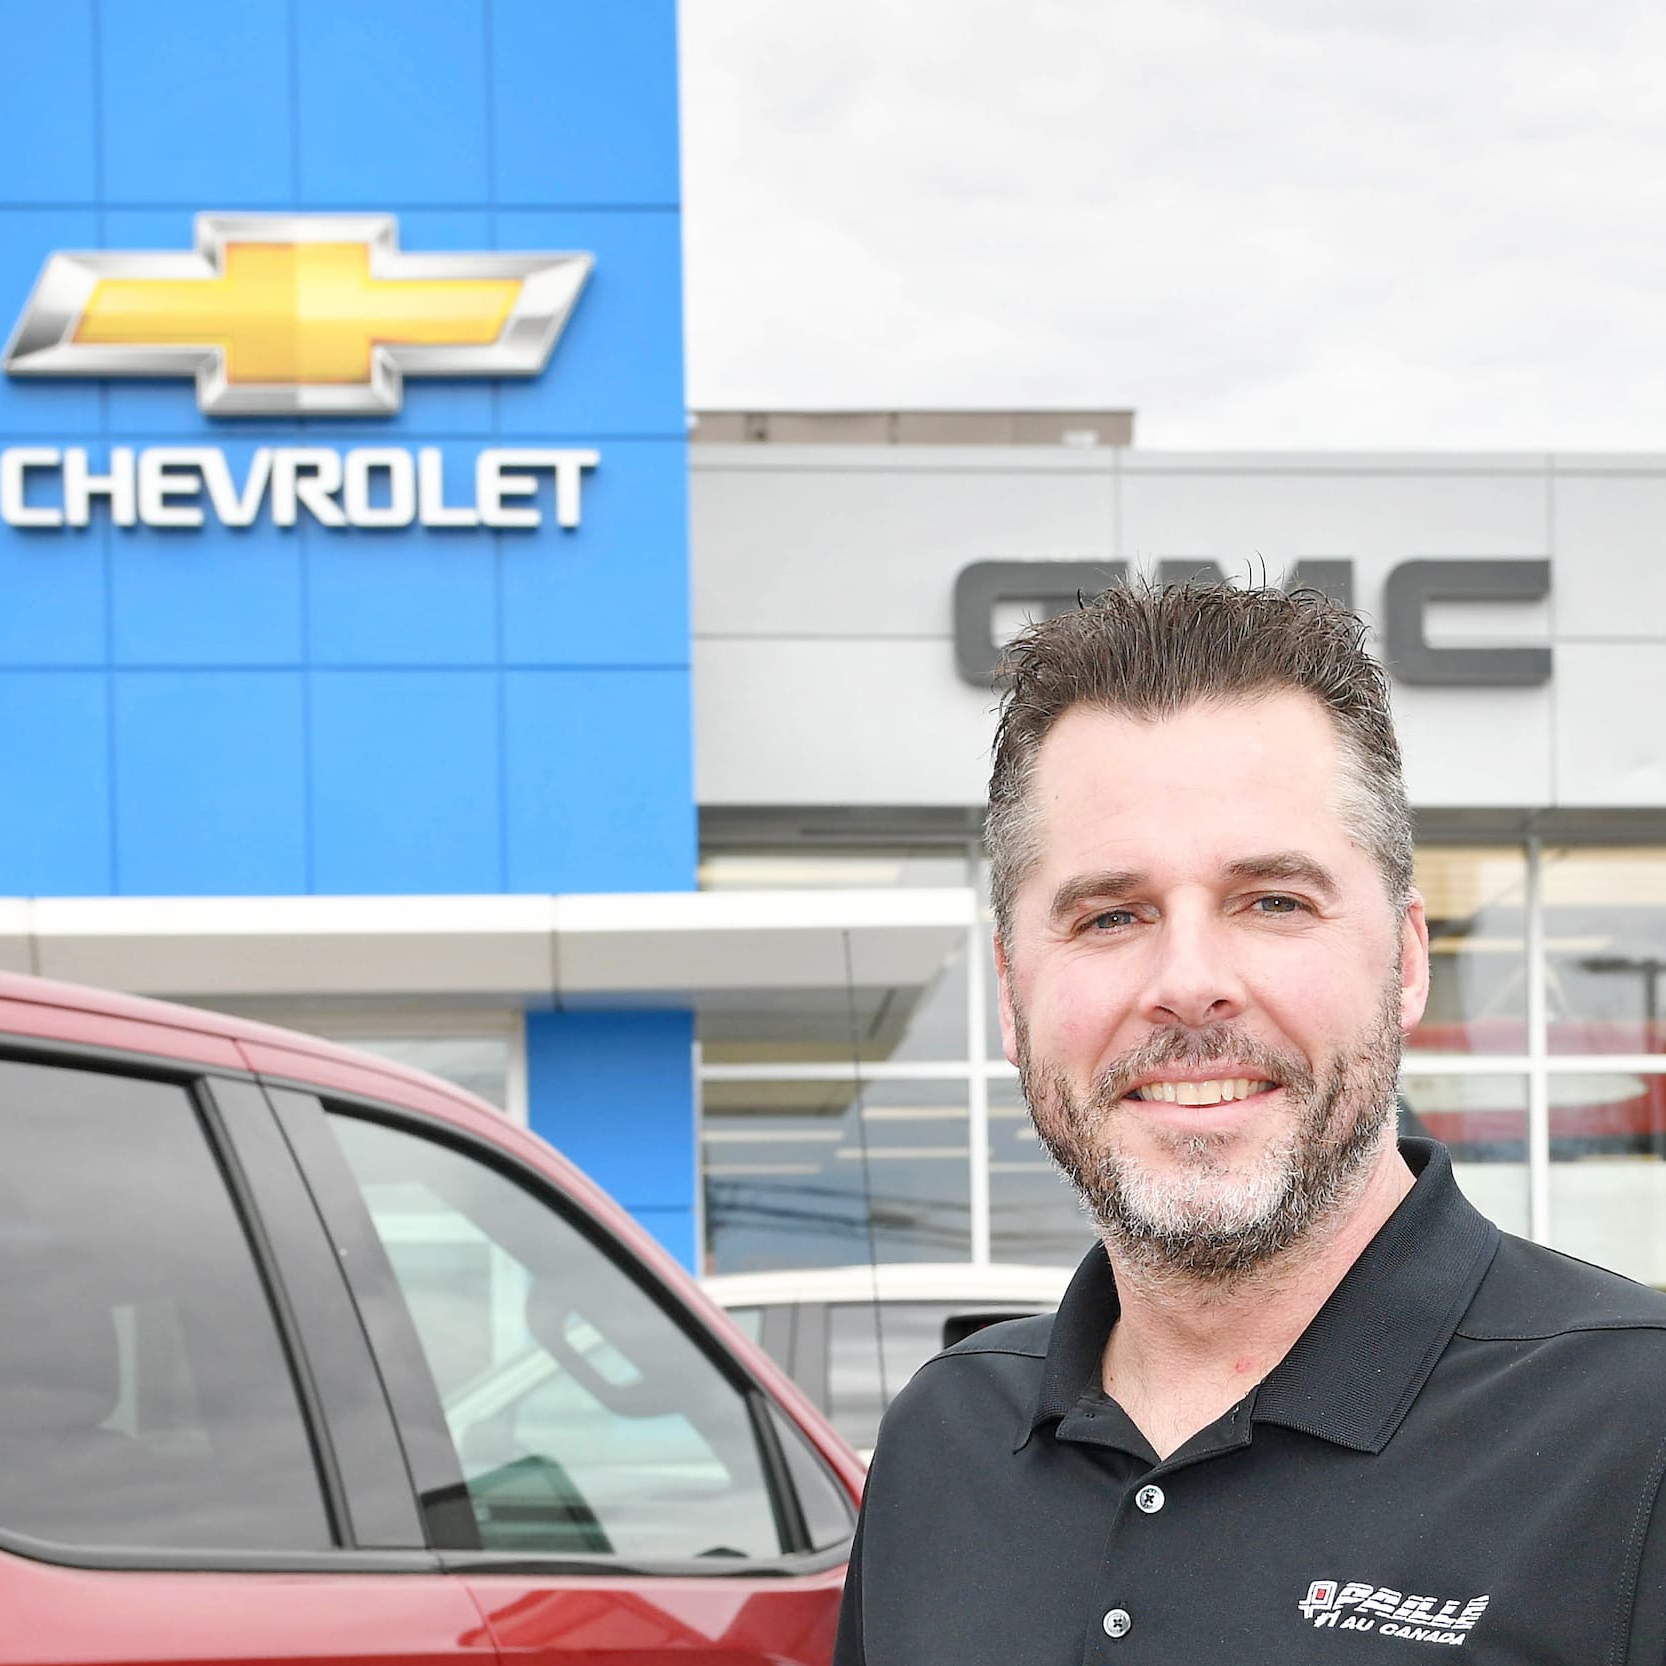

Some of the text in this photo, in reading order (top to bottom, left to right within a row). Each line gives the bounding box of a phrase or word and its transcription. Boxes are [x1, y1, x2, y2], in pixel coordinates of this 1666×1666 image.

[953, 558, 1552, 688] GC
[1314, 1610, 1466, 1646] #1 AU CANADA
